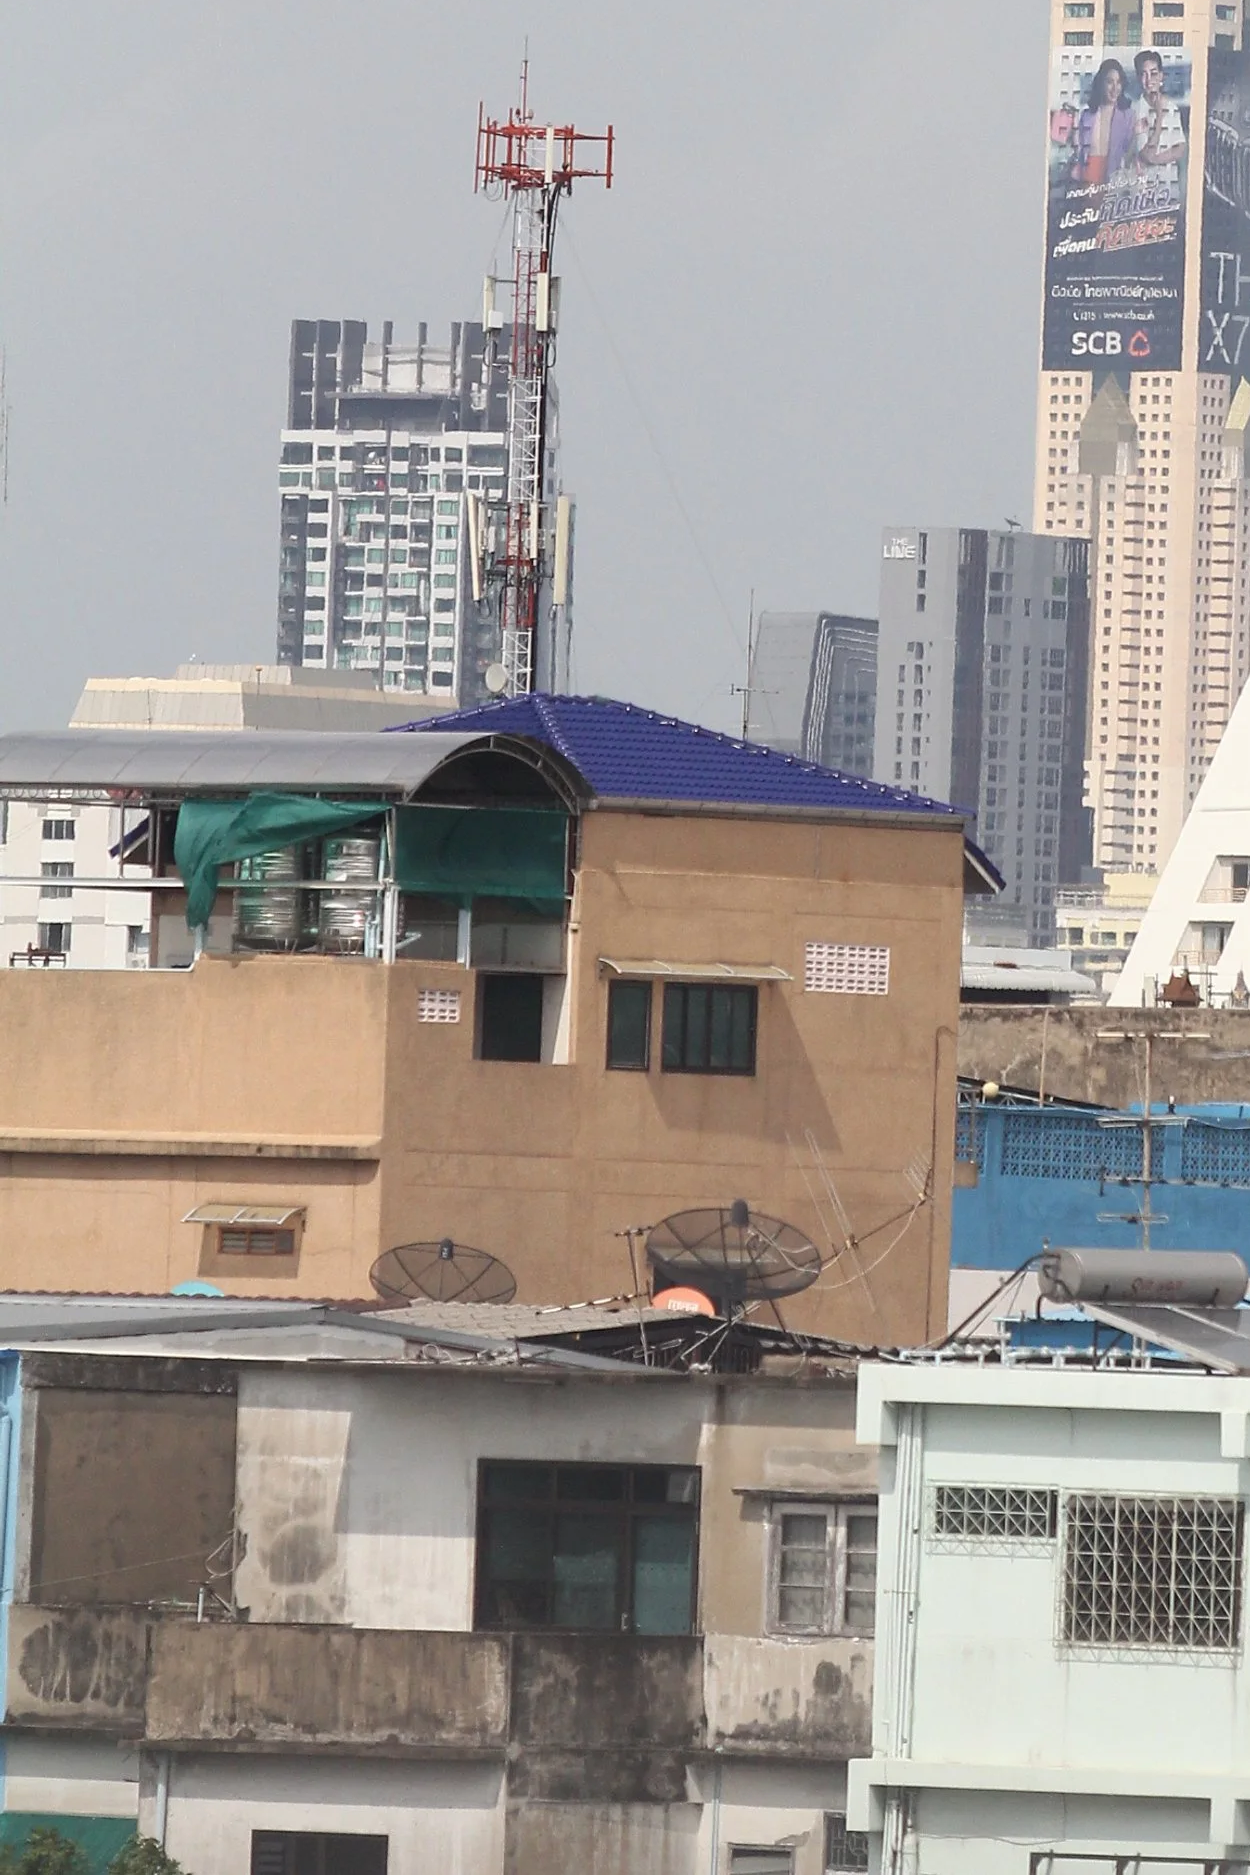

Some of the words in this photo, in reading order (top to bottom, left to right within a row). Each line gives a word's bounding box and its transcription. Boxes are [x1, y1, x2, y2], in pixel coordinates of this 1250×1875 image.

[1071, 331, 1123, 355] SCB
[1206, 310, 1250, 364] X7
[883, 545, 916, 558] LINE
